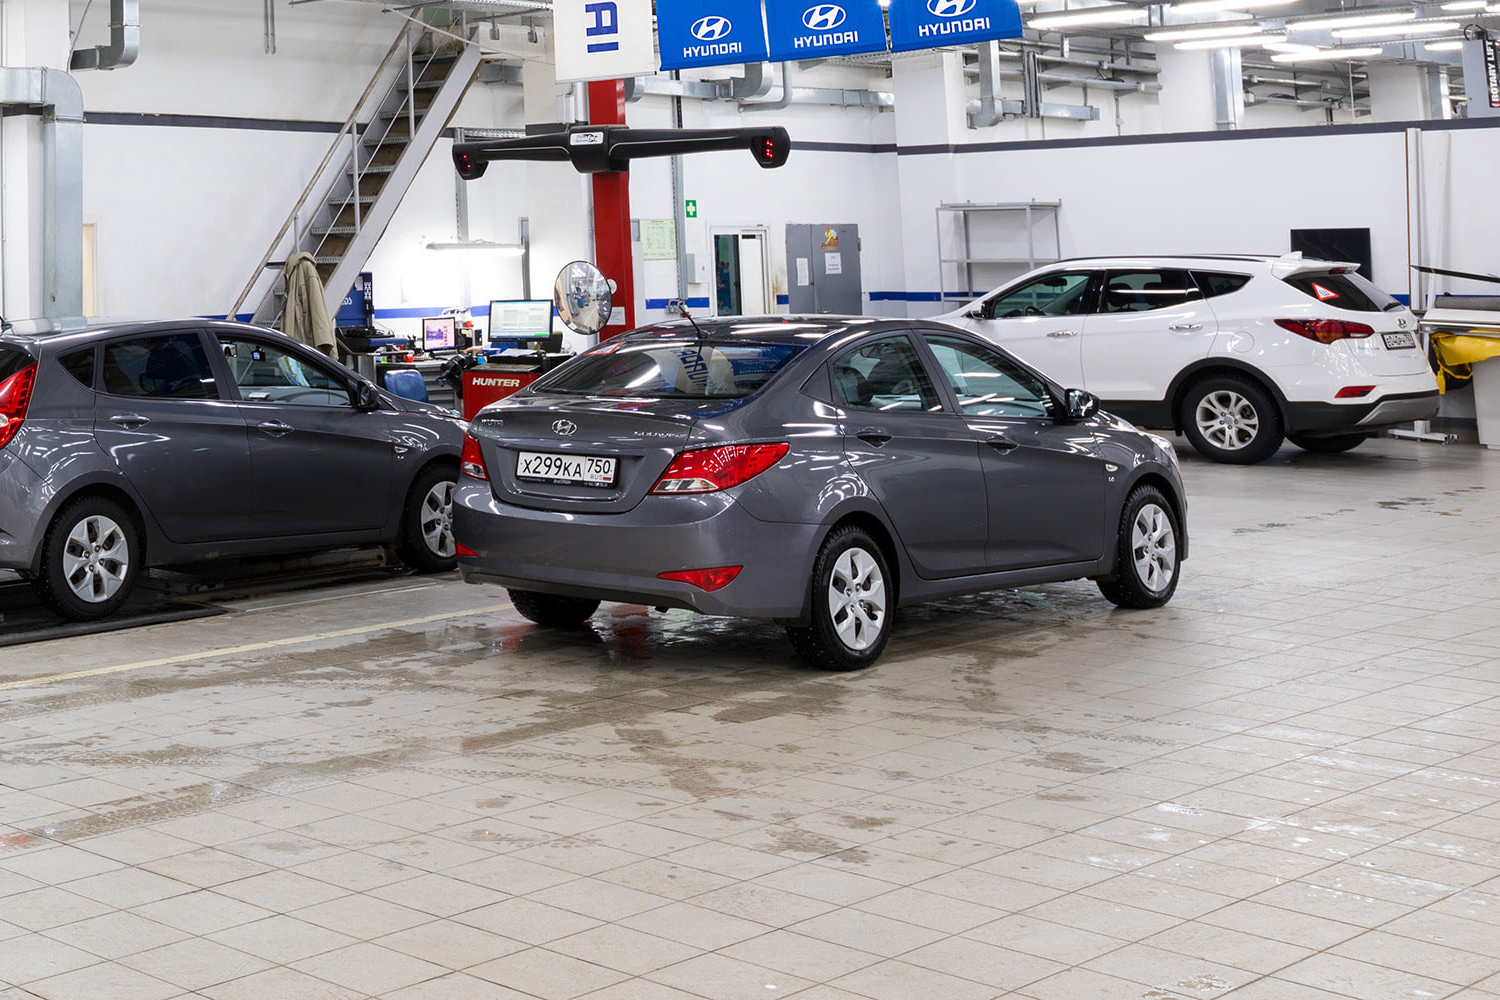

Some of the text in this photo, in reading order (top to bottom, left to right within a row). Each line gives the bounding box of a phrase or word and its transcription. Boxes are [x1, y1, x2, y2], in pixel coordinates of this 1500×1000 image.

[918, 16, 991, 37] HYUNDAI
[794, 30, 859, 49] HYUNDAI
[683, 41, 743, 58] HYUNDAI
[1485, 40, 1499, 102] ROTARY LIFT
[472, 377, 520, 388] HUNTER
[587, 459, 611, 474] 750
